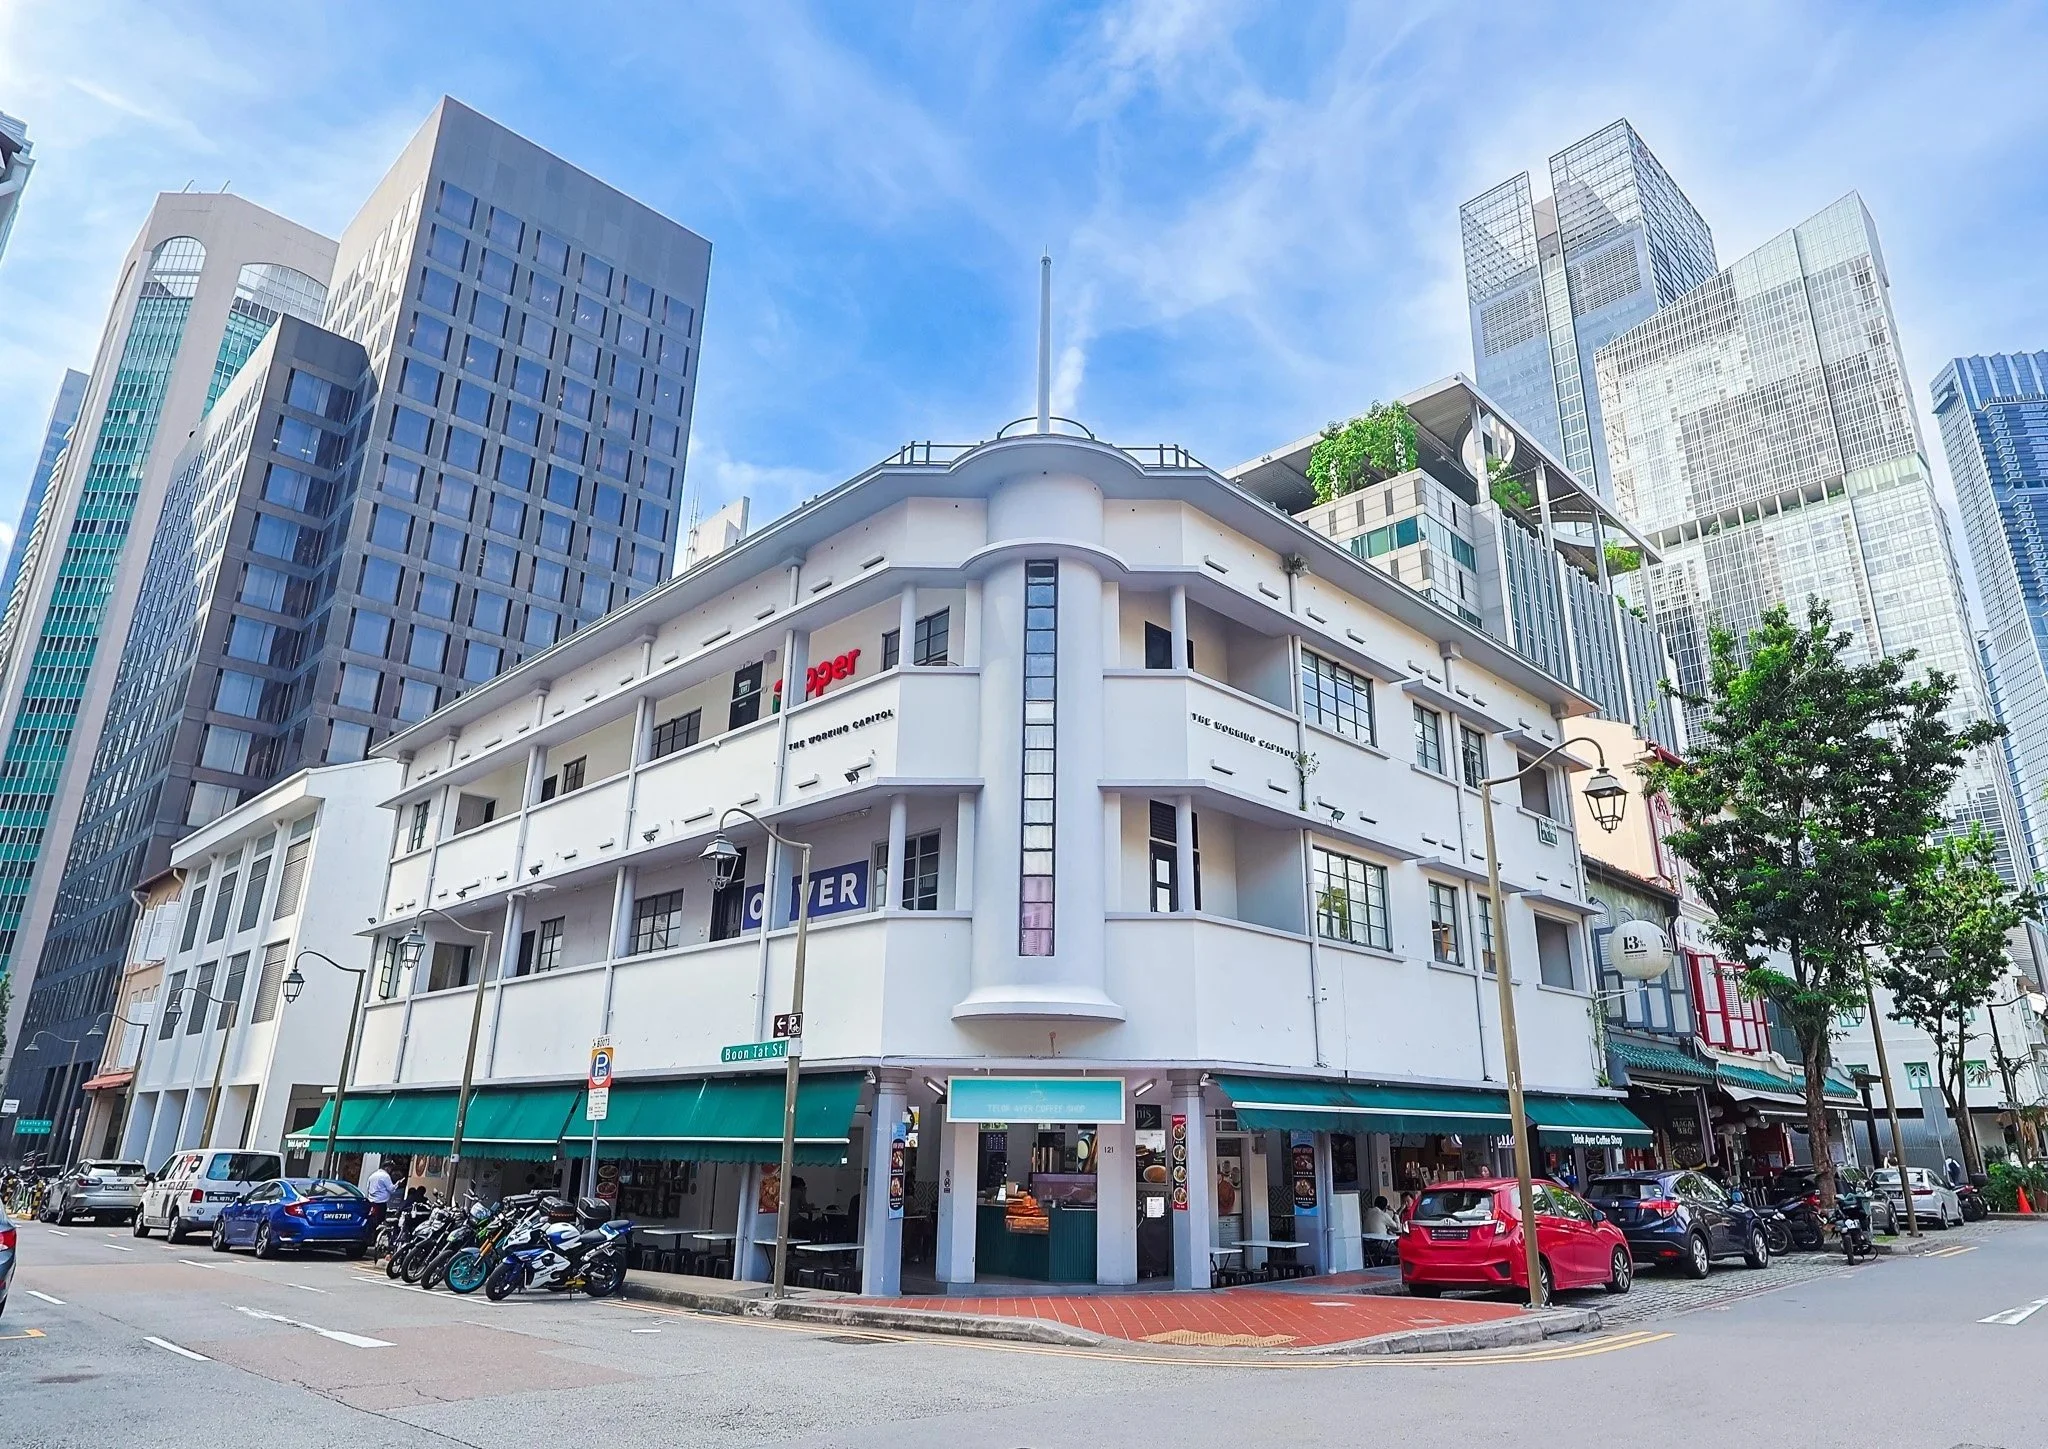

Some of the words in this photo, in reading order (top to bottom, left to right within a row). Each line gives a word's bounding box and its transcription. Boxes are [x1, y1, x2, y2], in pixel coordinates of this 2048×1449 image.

[788, 740, 806, 751] THE
[808, 725, 849, 745] WORKING
[852, 709, 893, 729] CAPITOL
[1191, 712, 1211, 726] THE
[1214, 721, 1256, 743] WORKING
[1258, 739, 1296, 760] CAPITOL
[749, 872, 859, 920] OVER
[725, 1048, 749, 1060] Boon
[753, 1045, 768, 1058] Tat
[772, 1043, 783, 1056] St
[1035, 1104, 1062, 1113] COFFEE
[1571, 1133, 1585, 1144] Telok
[1585, 1134, 1596, 1147] Ayer
[1596, 1134, 1611, 1145] Coffee
[1611, 1134, 1623, 1147] Shop
[1104, 1146, 1114, 1154] 121
